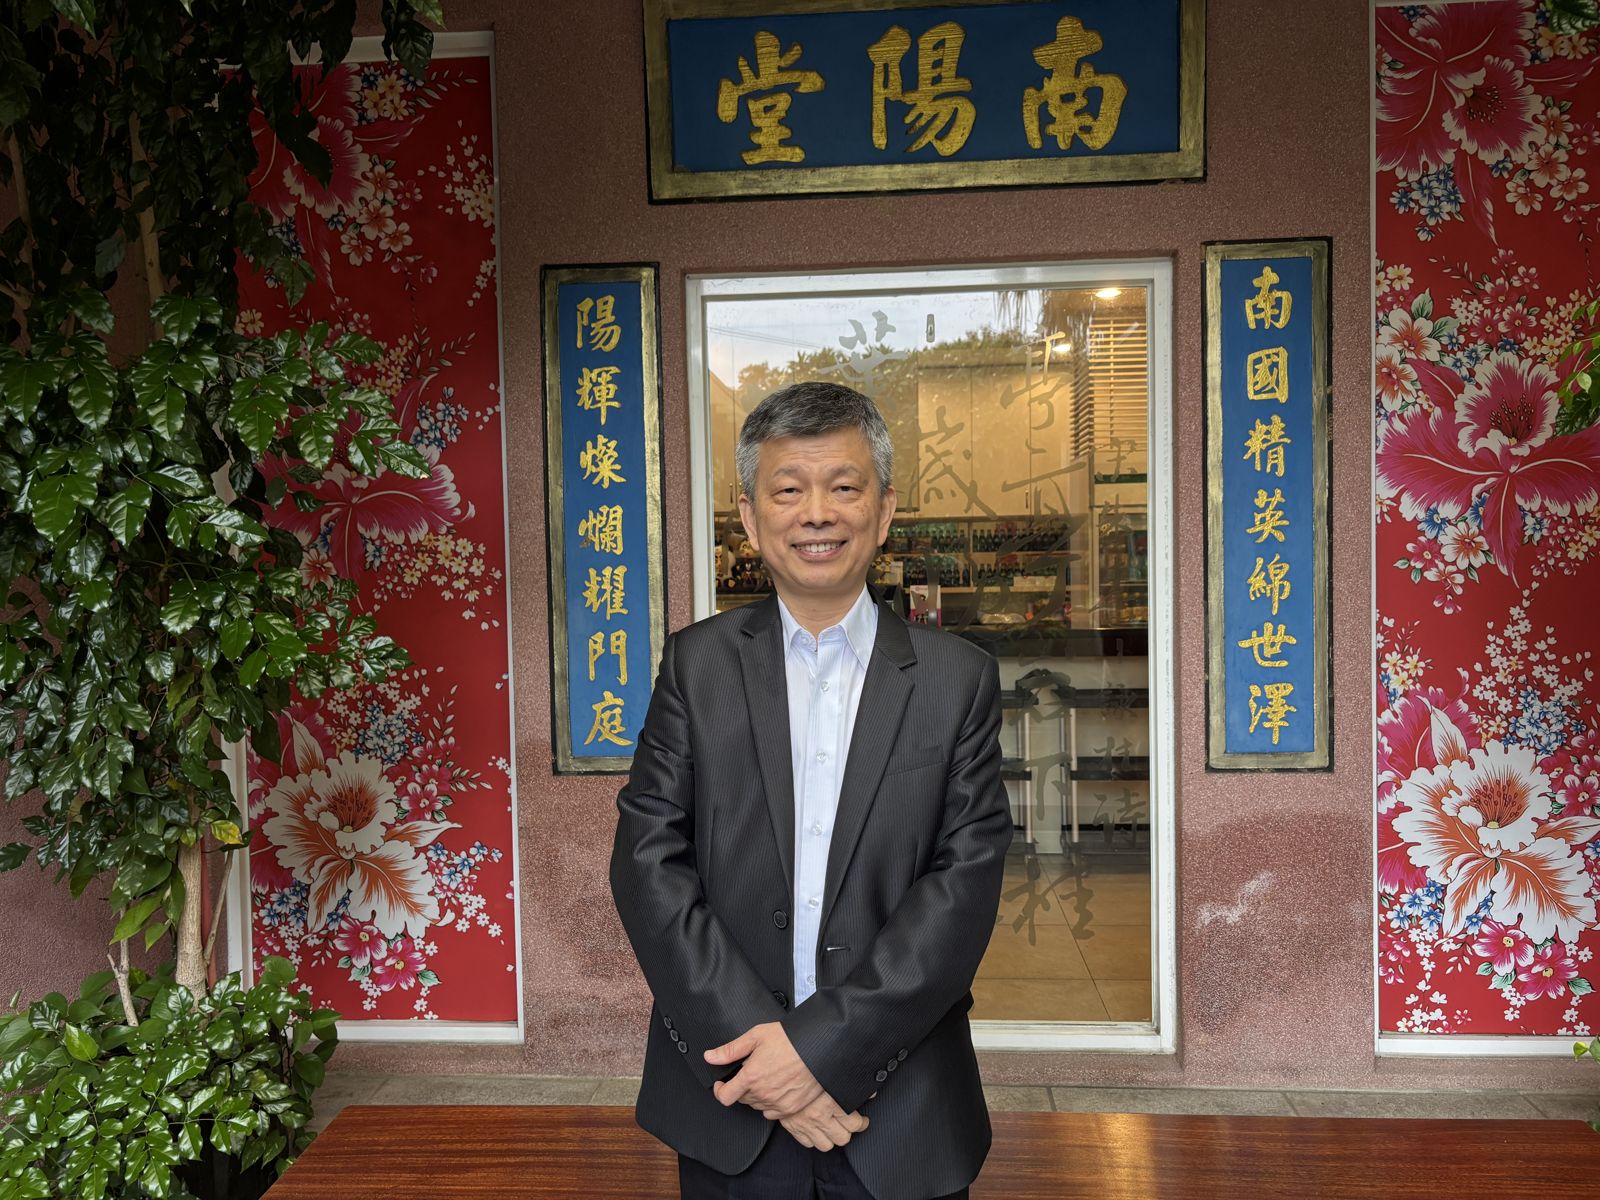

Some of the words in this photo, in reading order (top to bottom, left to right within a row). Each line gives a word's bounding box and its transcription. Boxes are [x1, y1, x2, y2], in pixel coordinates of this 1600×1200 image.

[576, 295, 634, 746] 陽輝燦爛耀門庭
[1238, 266, 1297, 744] 南國精英綿世澤
